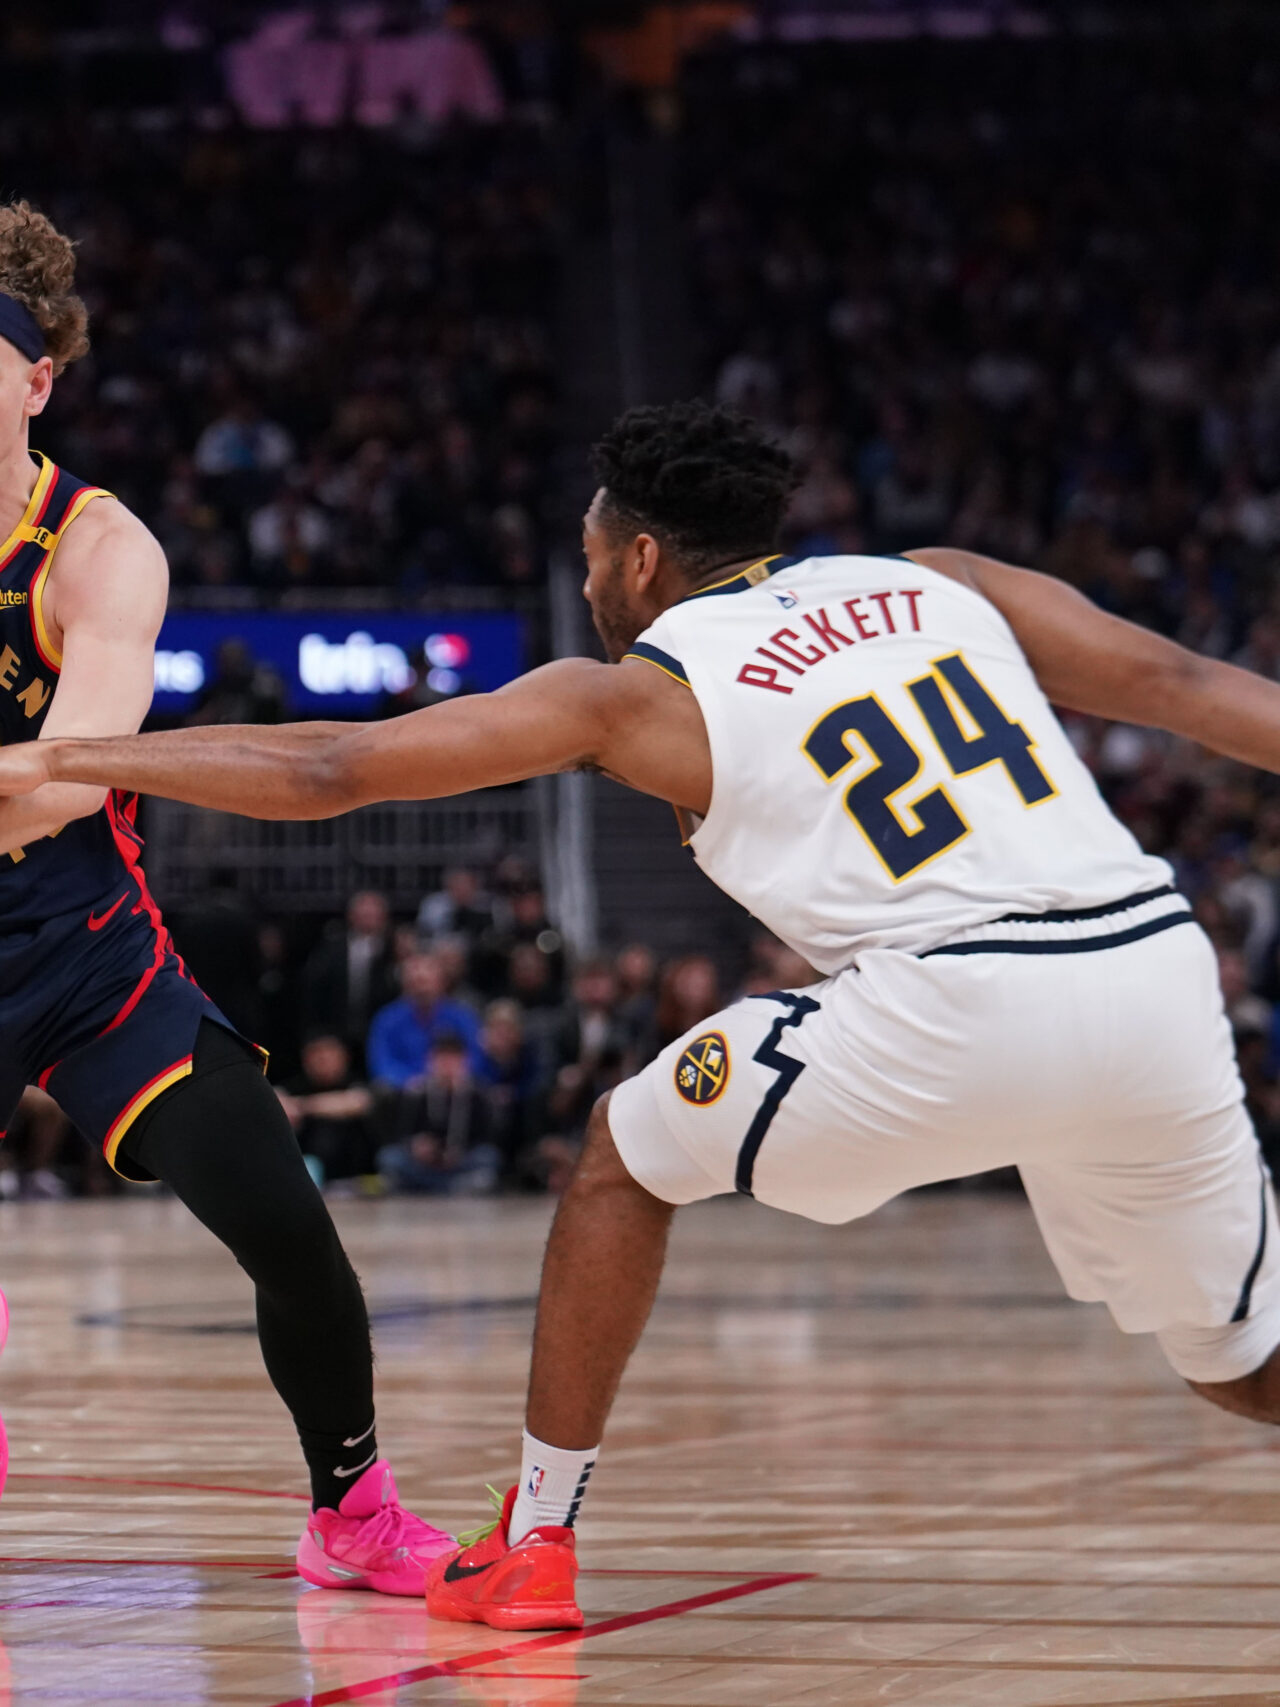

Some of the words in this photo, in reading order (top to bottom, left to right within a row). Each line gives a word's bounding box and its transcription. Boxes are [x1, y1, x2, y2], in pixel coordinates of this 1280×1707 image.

[33, 528, 49, 544] 16
[735, 590, 923, 695] PICKETT
[799, 649, 1060, 885] 24
